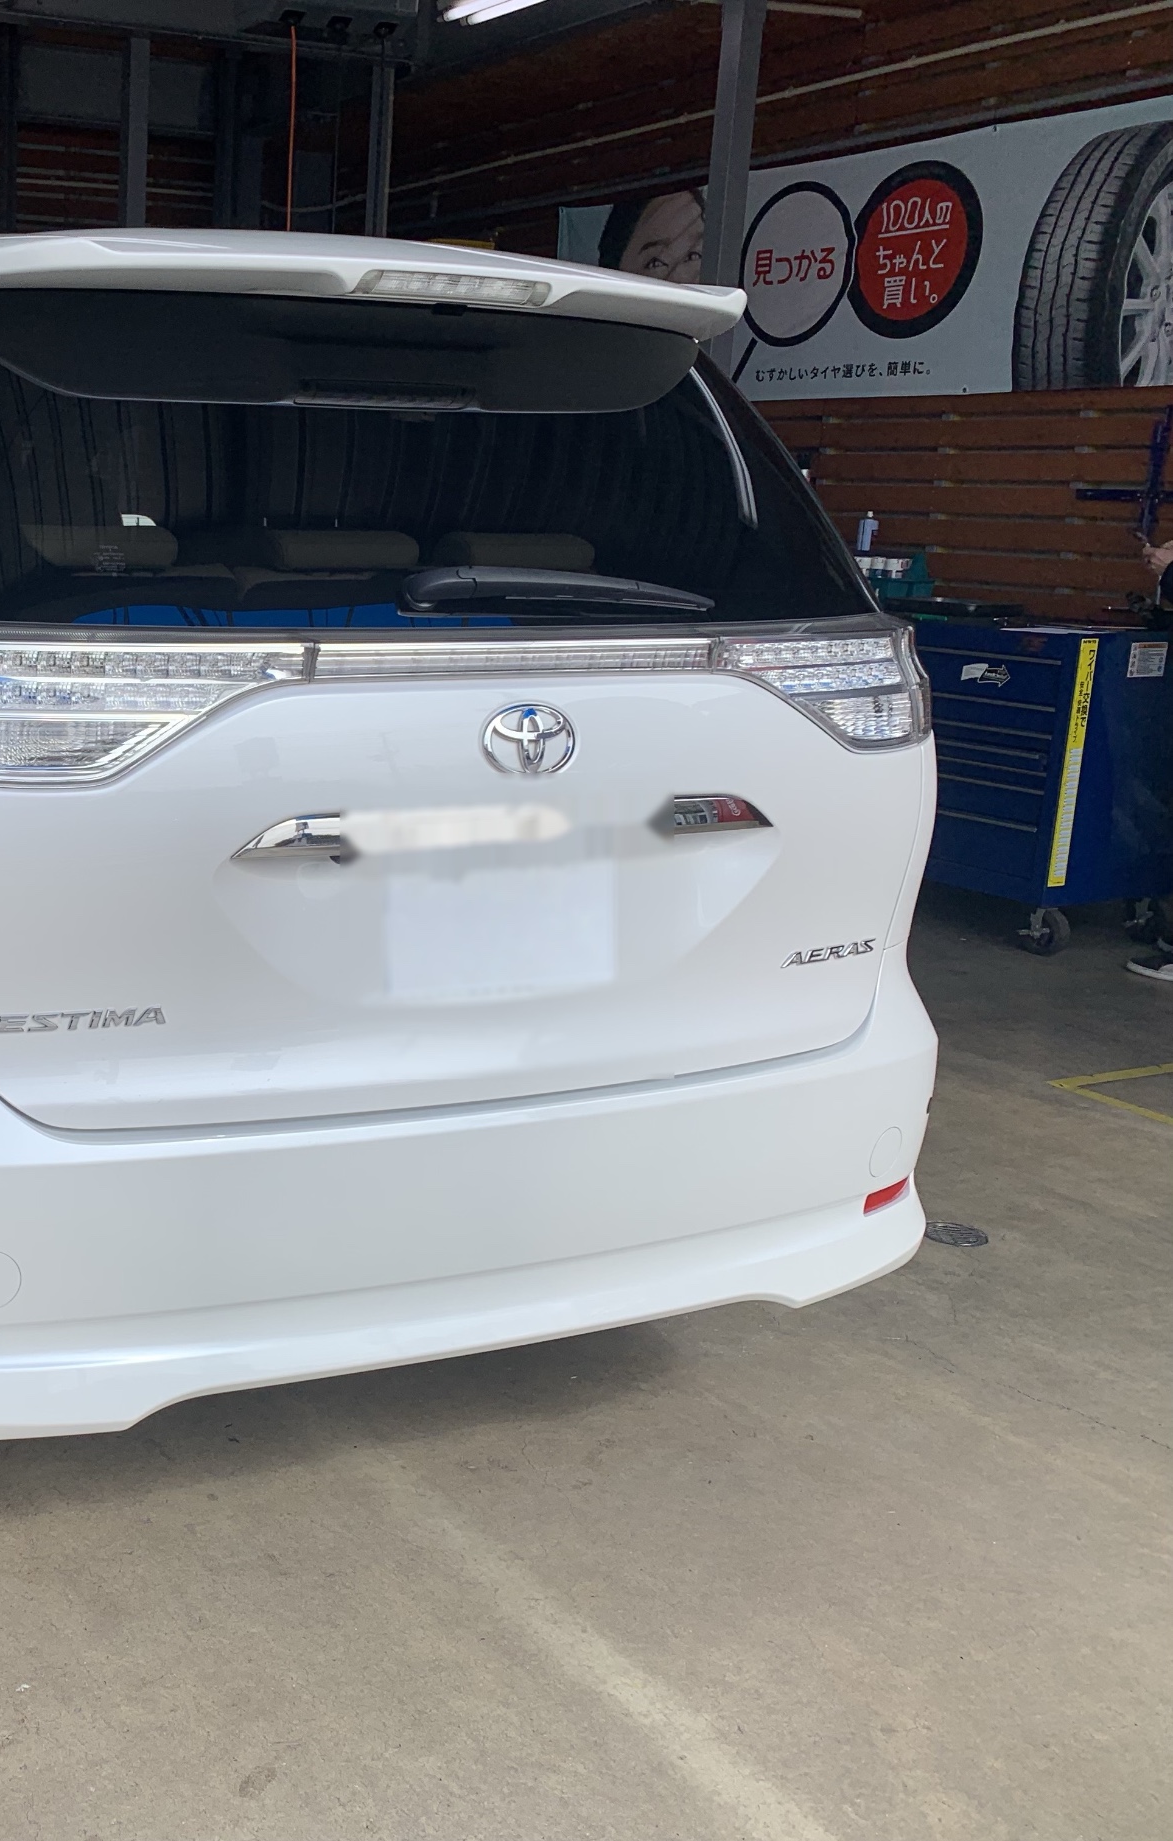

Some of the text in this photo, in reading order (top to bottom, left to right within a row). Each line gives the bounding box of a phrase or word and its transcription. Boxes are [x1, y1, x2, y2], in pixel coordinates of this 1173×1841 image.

[881, 197, 953, 233] 100人の
[752, 247, 836, 288] 見つかる
[876, 238, 948, 275] ちゃんと
[882, 276, 938, 310] 買い。
[755, 360, 931, 383] むずかしいタイヤ選びを、簡単に。
[780, 938, 877, 969] AERAS
